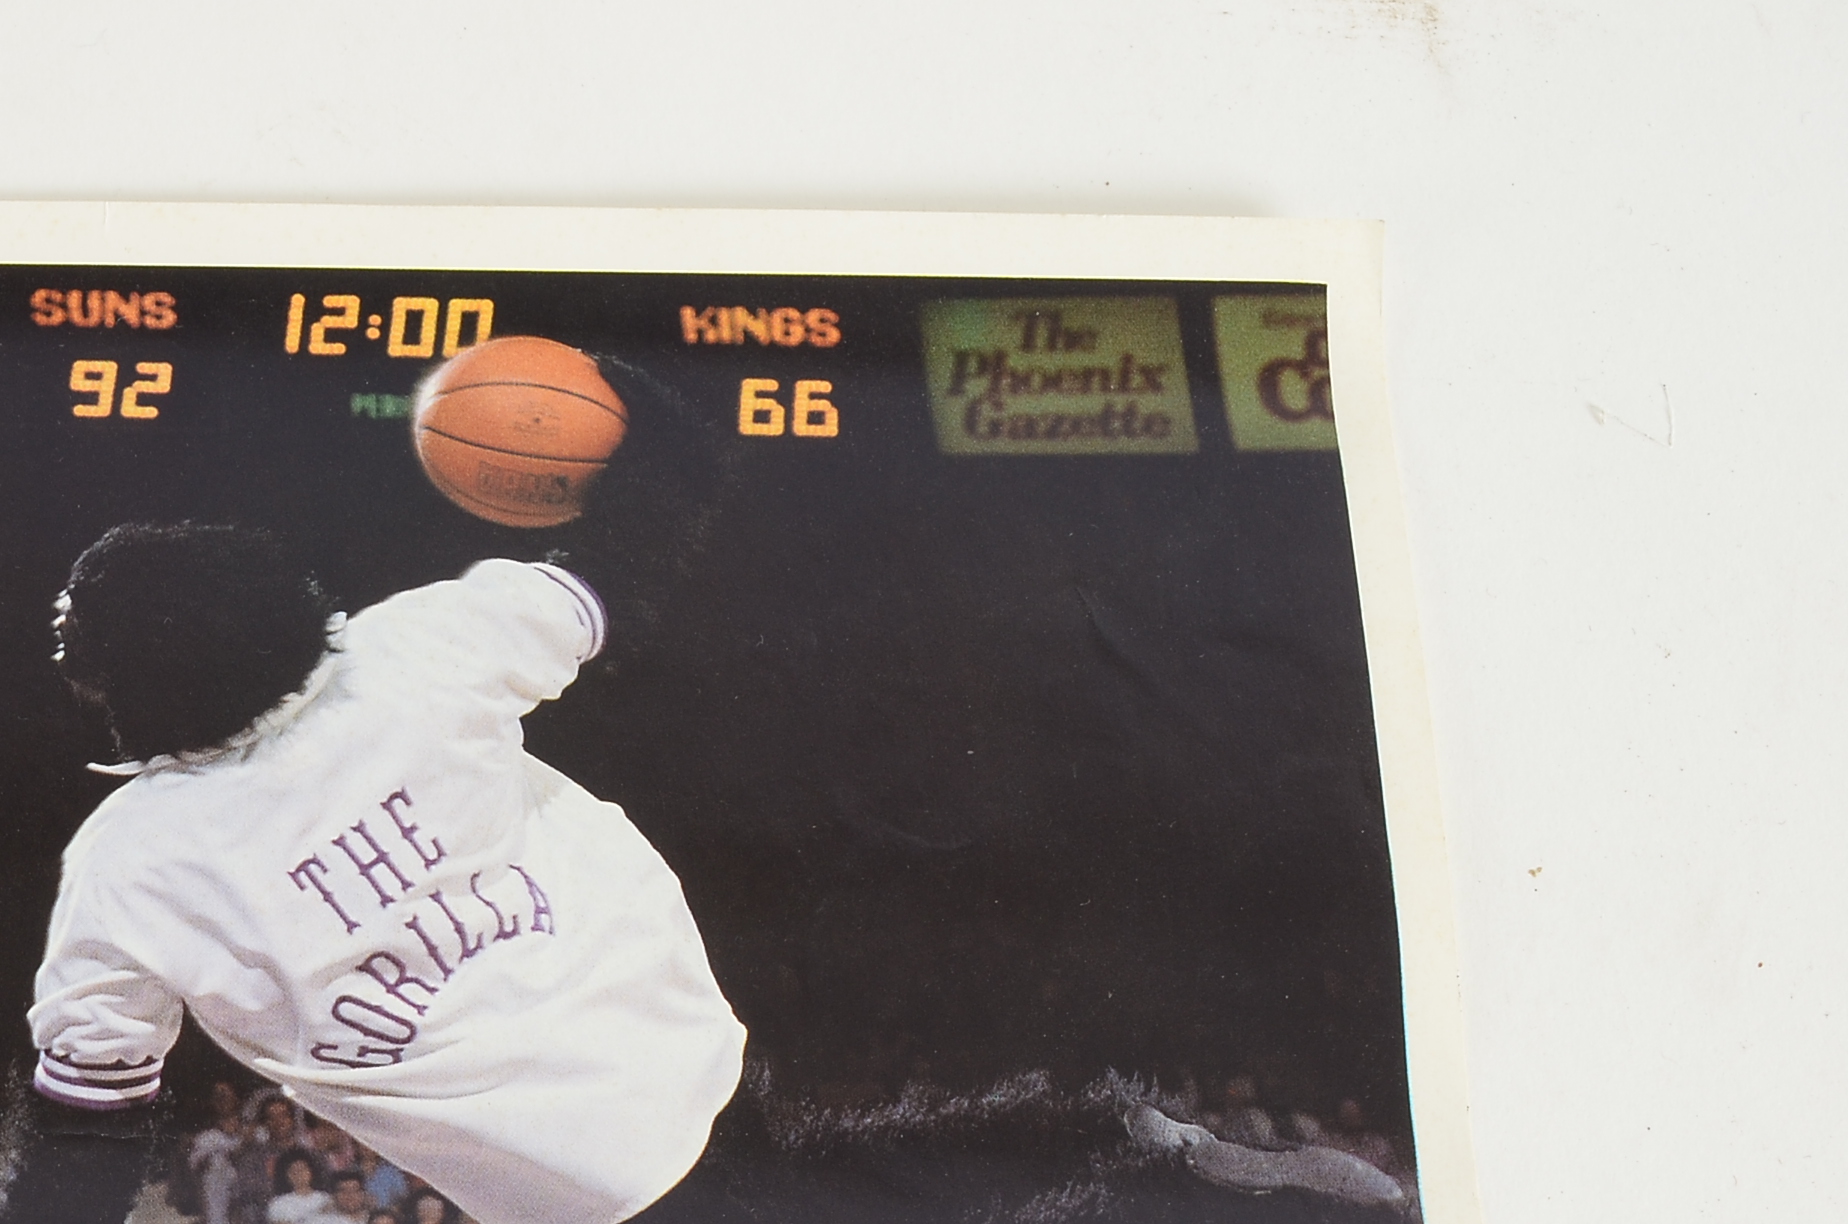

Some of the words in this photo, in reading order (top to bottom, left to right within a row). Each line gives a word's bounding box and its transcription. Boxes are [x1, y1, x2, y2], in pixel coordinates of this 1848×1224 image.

[30, 286, 177, 330] SUNS
[283, 292, 495, 359] 12:00
[680, 305, 842, 348] KINGS
[1012, 307, 1099, 353] The
[68, 359, 174, 420] 92
[948, 349, 1168, 402] Phoenix
[736, 377, 840, 438] 66
[963, 399, 1173, 442] Gazette
[286, 786, 448, 936] THE
[309, 862, 557, 1070] GORILLA
